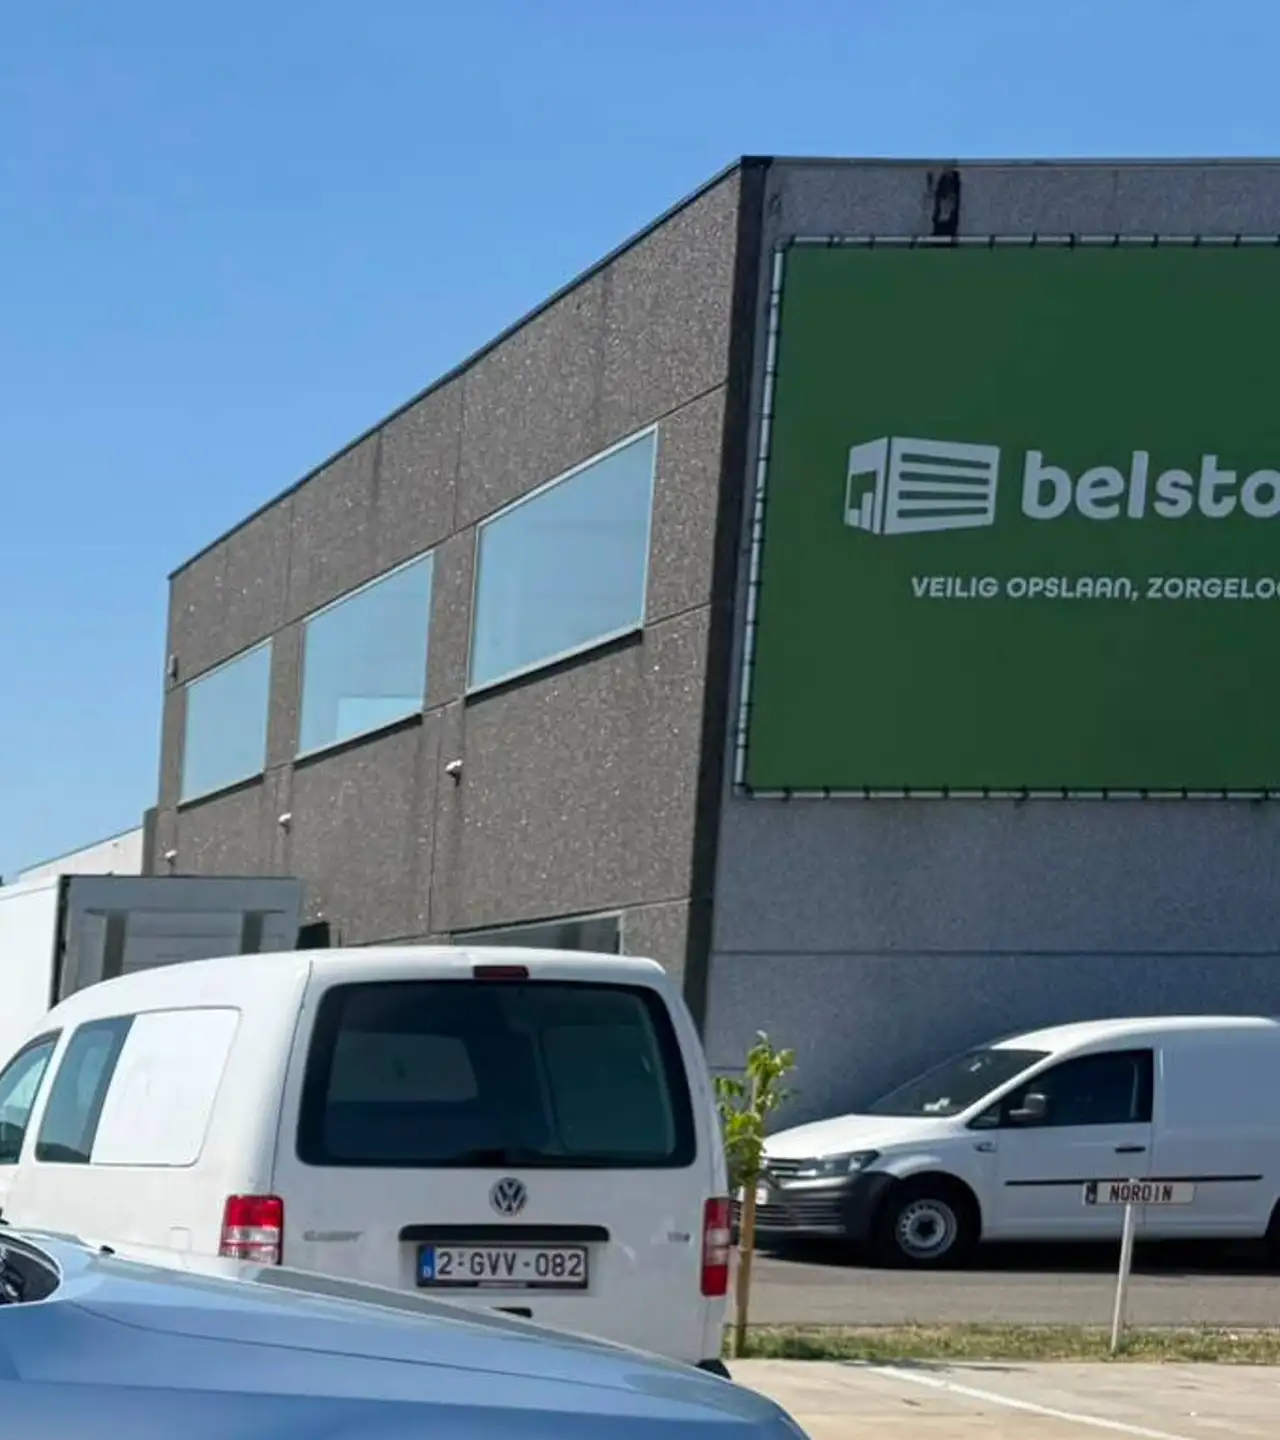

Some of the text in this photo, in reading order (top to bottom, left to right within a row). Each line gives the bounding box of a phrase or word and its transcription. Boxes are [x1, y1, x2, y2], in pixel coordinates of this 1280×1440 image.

[1022, 450, 1280, 520] belsto
[911, 576, 1280, 602] VEILIG OPSLAAN, ZORGELO
